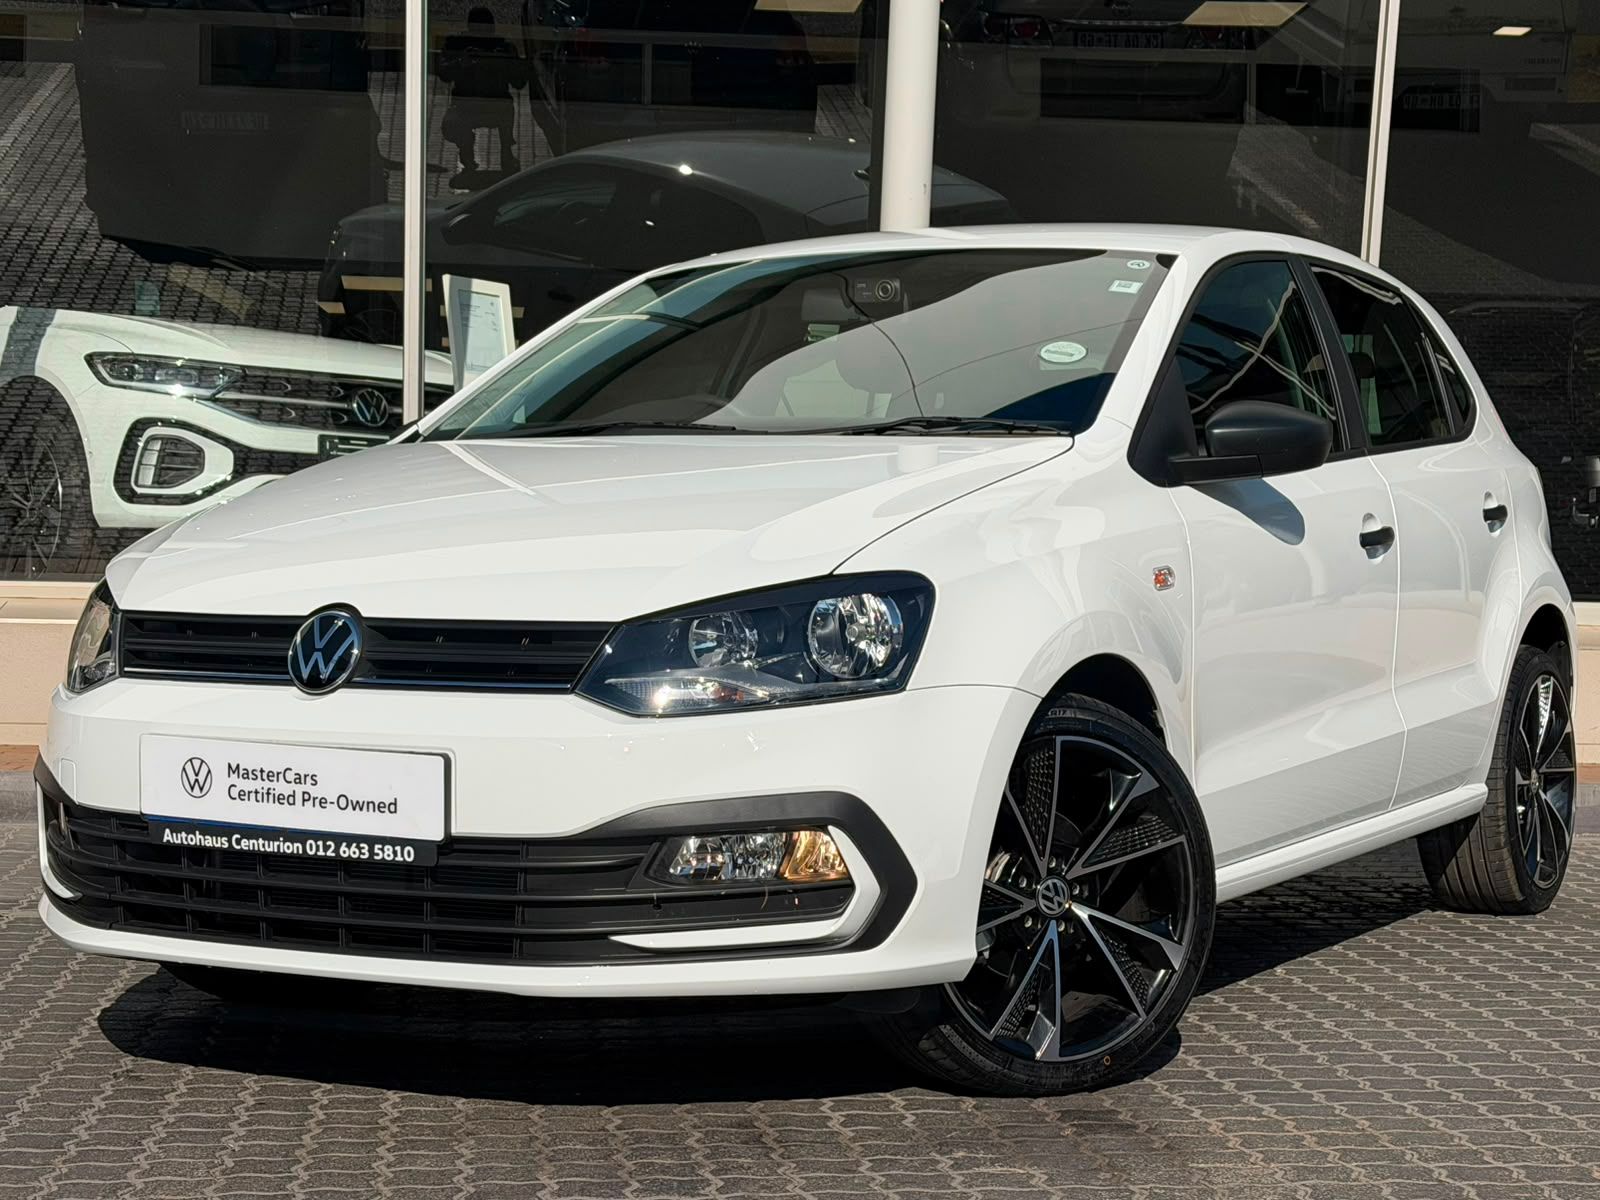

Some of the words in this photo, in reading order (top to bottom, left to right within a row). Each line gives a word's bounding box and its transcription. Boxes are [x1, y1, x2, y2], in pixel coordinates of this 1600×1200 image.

[289, 611, 361, 692] VW
[181, 757, 212, 798] VW
[227, 762, 318, 786] MasterCars
[227, 784, 296, 806] Certified
[301, 791, 398, 814] Pre-Owned
[163, 828, 229, 848] Autohaus
[231, 834, 303, 854] Centurion
[306, 840, 336, 857] 012
[339, 842, 369, 859] 663
[373, 844, 415, 862] 5810
[1039, 879, 1068, 915] VW
